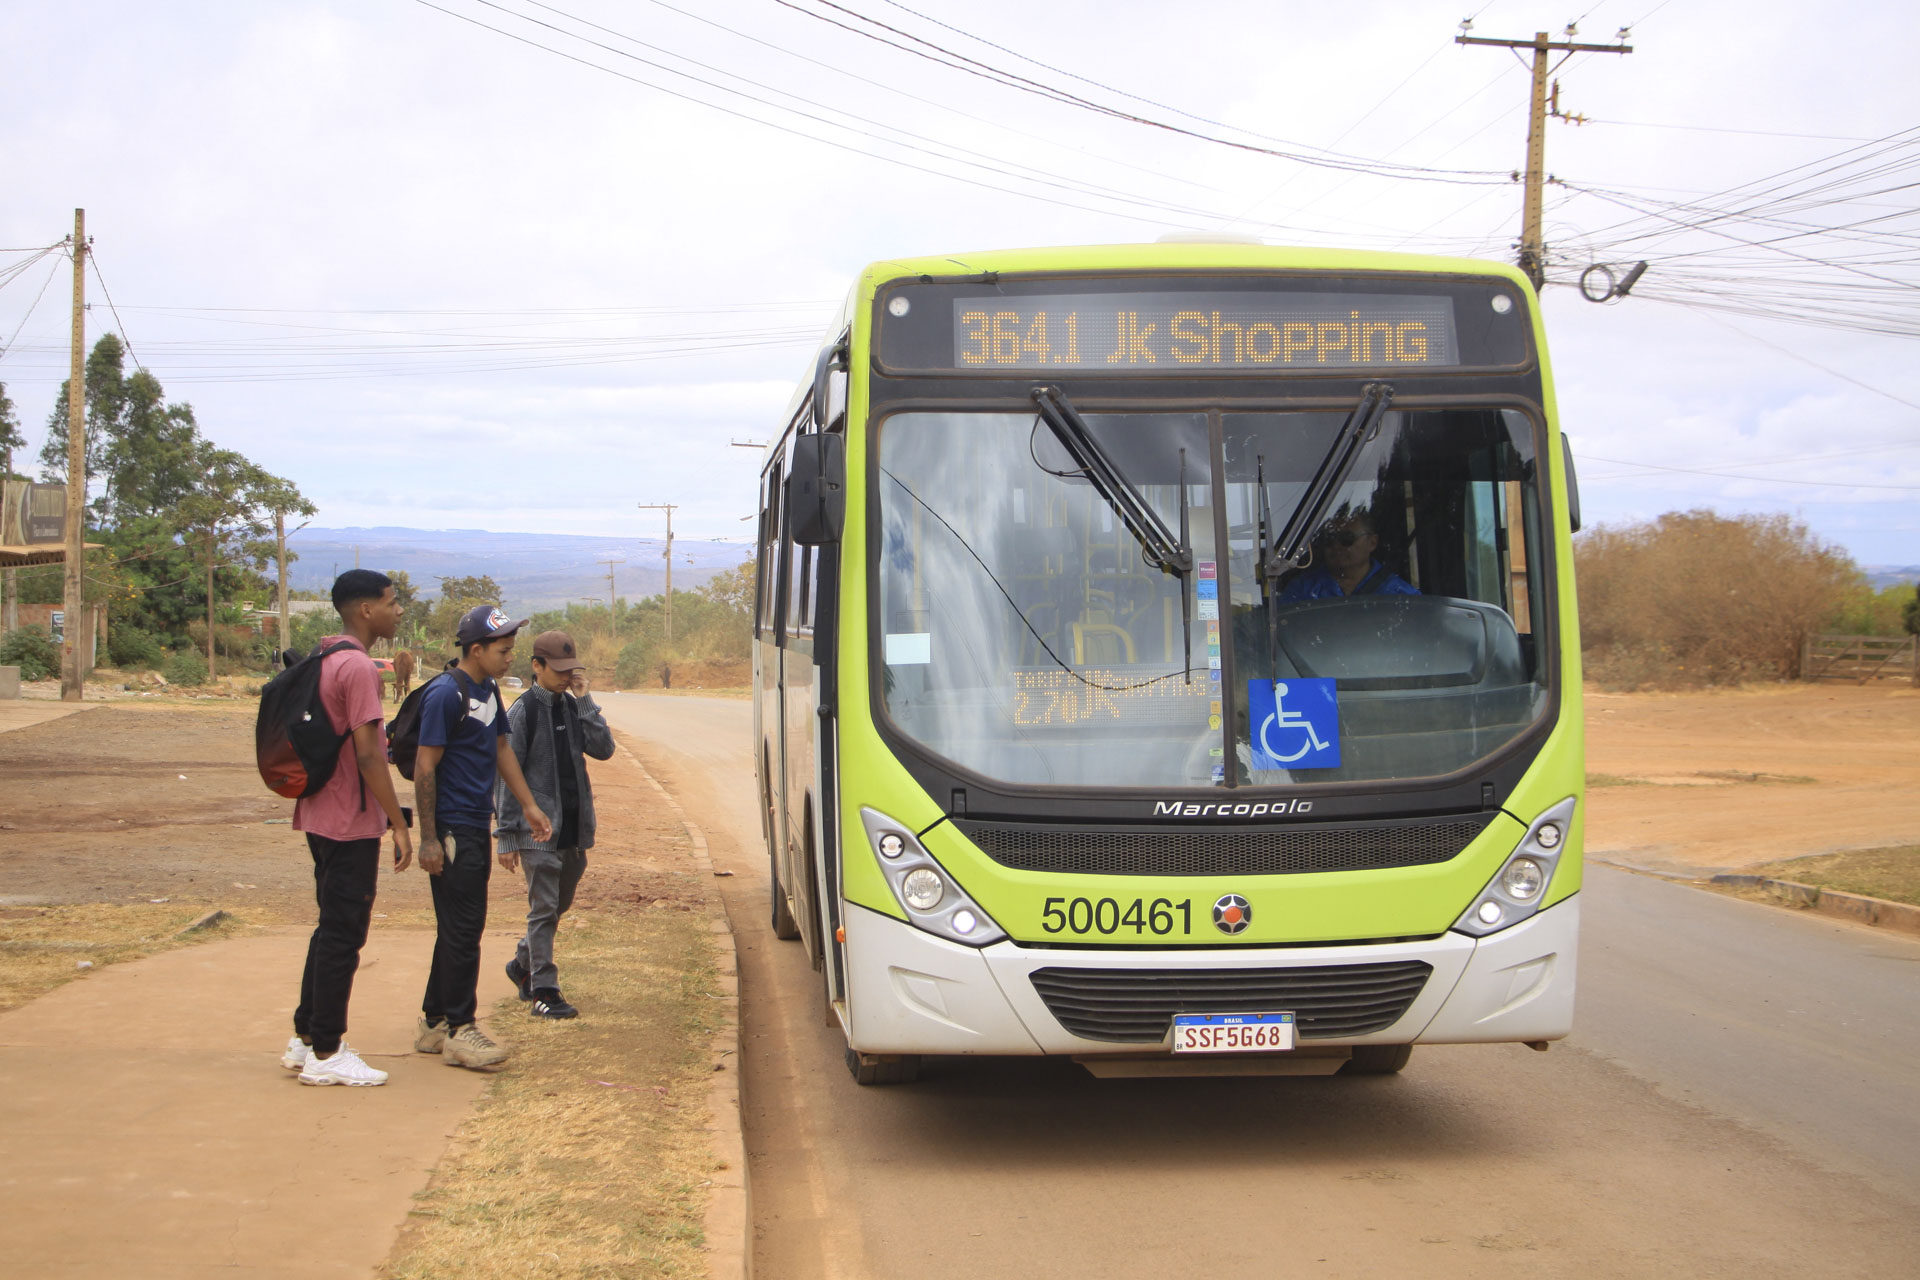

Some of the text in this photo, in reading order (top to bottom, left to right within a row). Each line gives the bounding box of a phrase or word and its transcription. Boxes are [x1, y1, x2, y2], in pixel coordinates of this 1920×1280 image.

[962, 311, 1081, 364] 364.1
[1153, 799, 1314, 818] Marcopolo
[1041, 897, 1191, 935] 500461
[1185, 1026, 1280, 1048] SSF5G68
